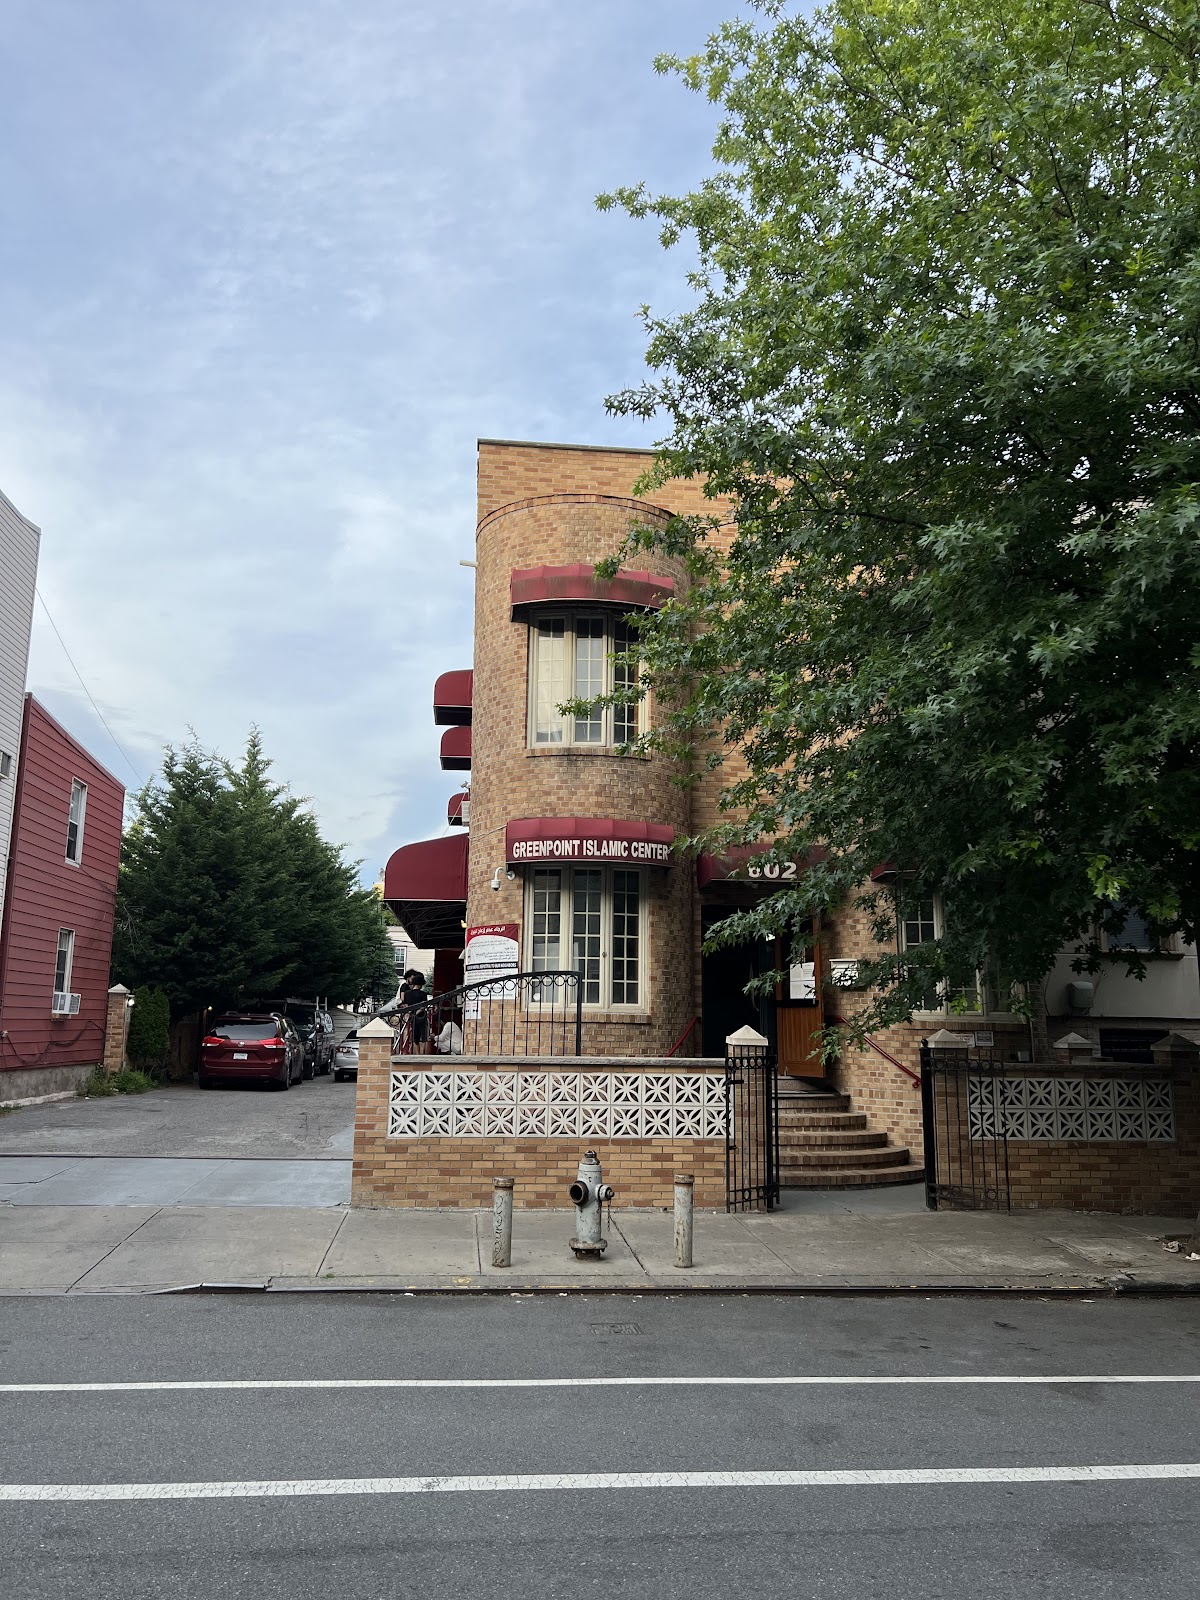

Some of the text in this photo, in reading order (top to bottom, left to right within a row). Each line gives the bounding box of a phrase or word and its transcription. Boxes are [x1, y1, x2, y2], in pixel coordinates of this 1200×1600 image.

[512, 839, 669, 860] GREENPOINT ISLAMIC CENTER
